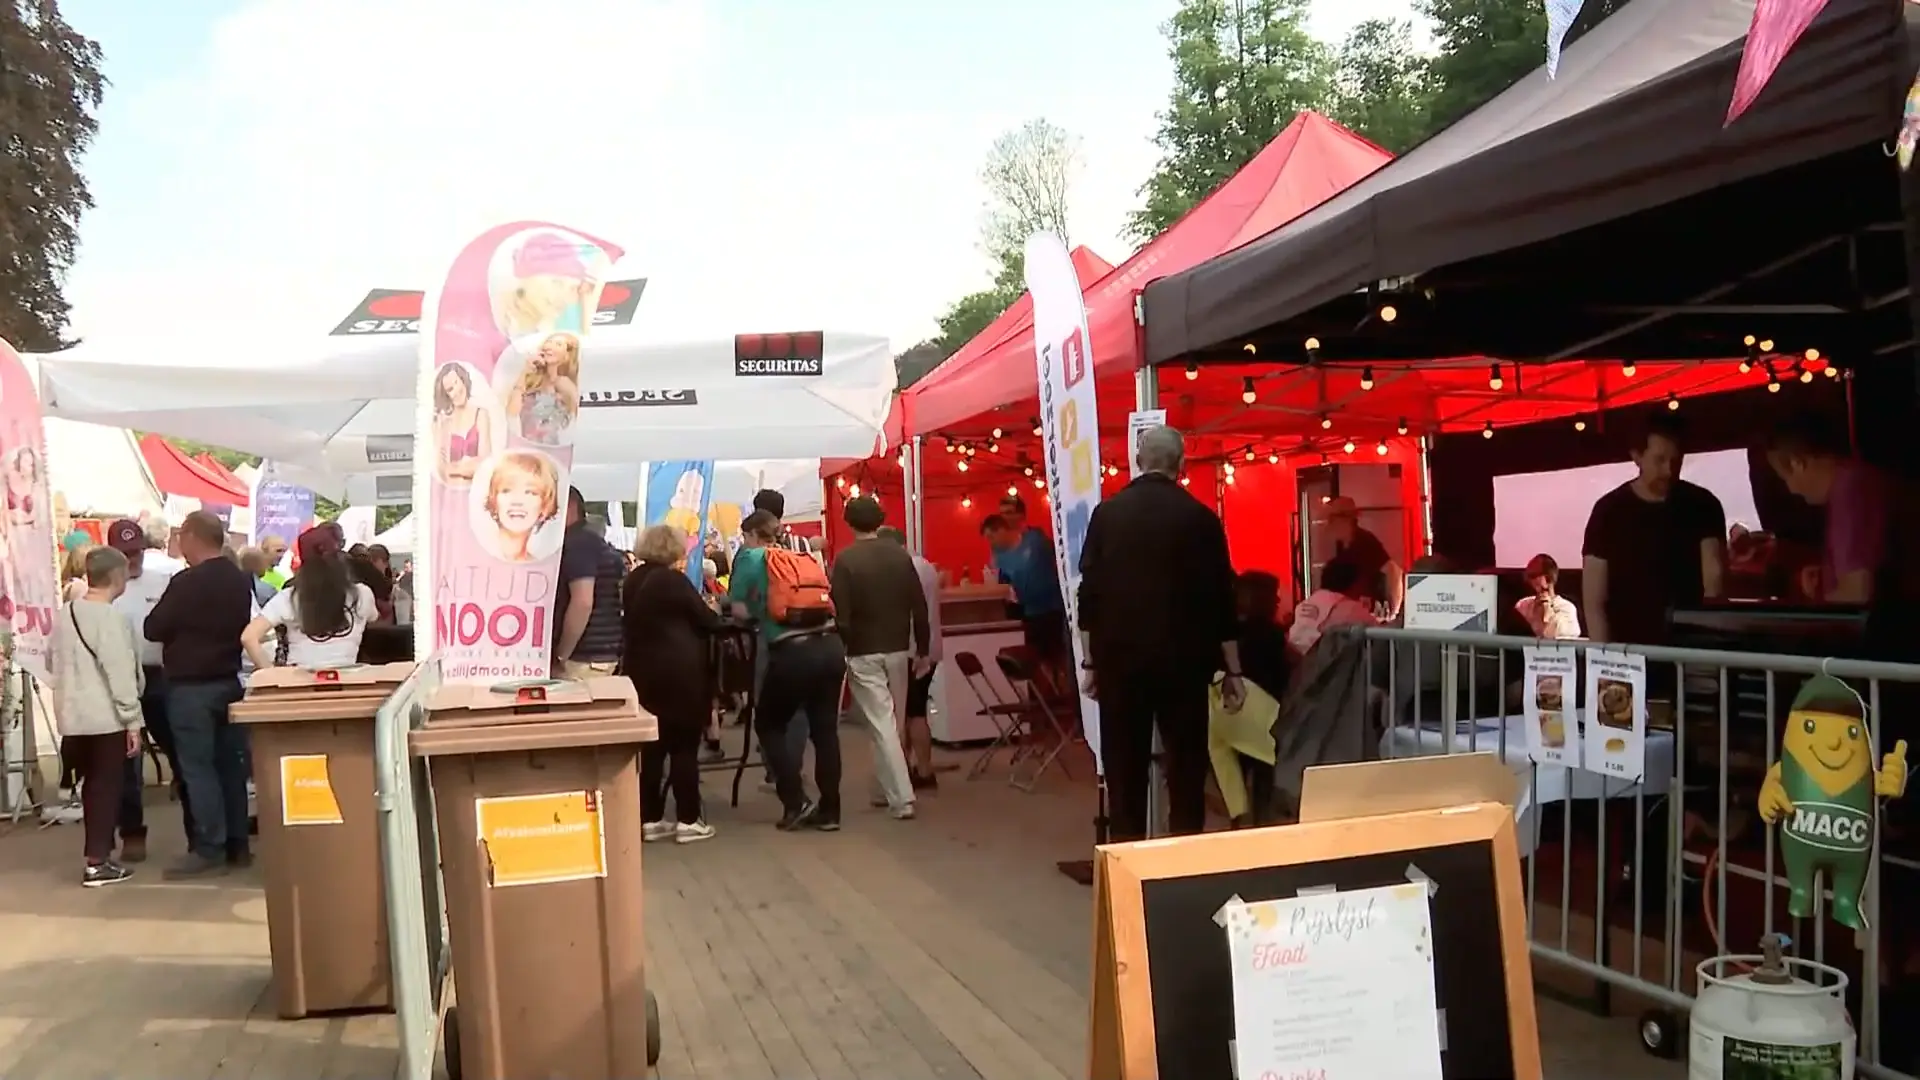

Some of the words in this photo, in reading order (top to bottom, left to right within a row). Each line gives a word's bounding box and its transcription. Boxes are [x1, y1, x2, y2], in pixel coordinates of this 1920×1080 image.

[739, 359, 818, 373] SECURITAS
[436, 565, 549, 603] ALTIJD
[1436, 592, 1456, 602] TEAM
[1792, 808, 1868, 843] MACC
[1252, 943, 1308, 970] Food
